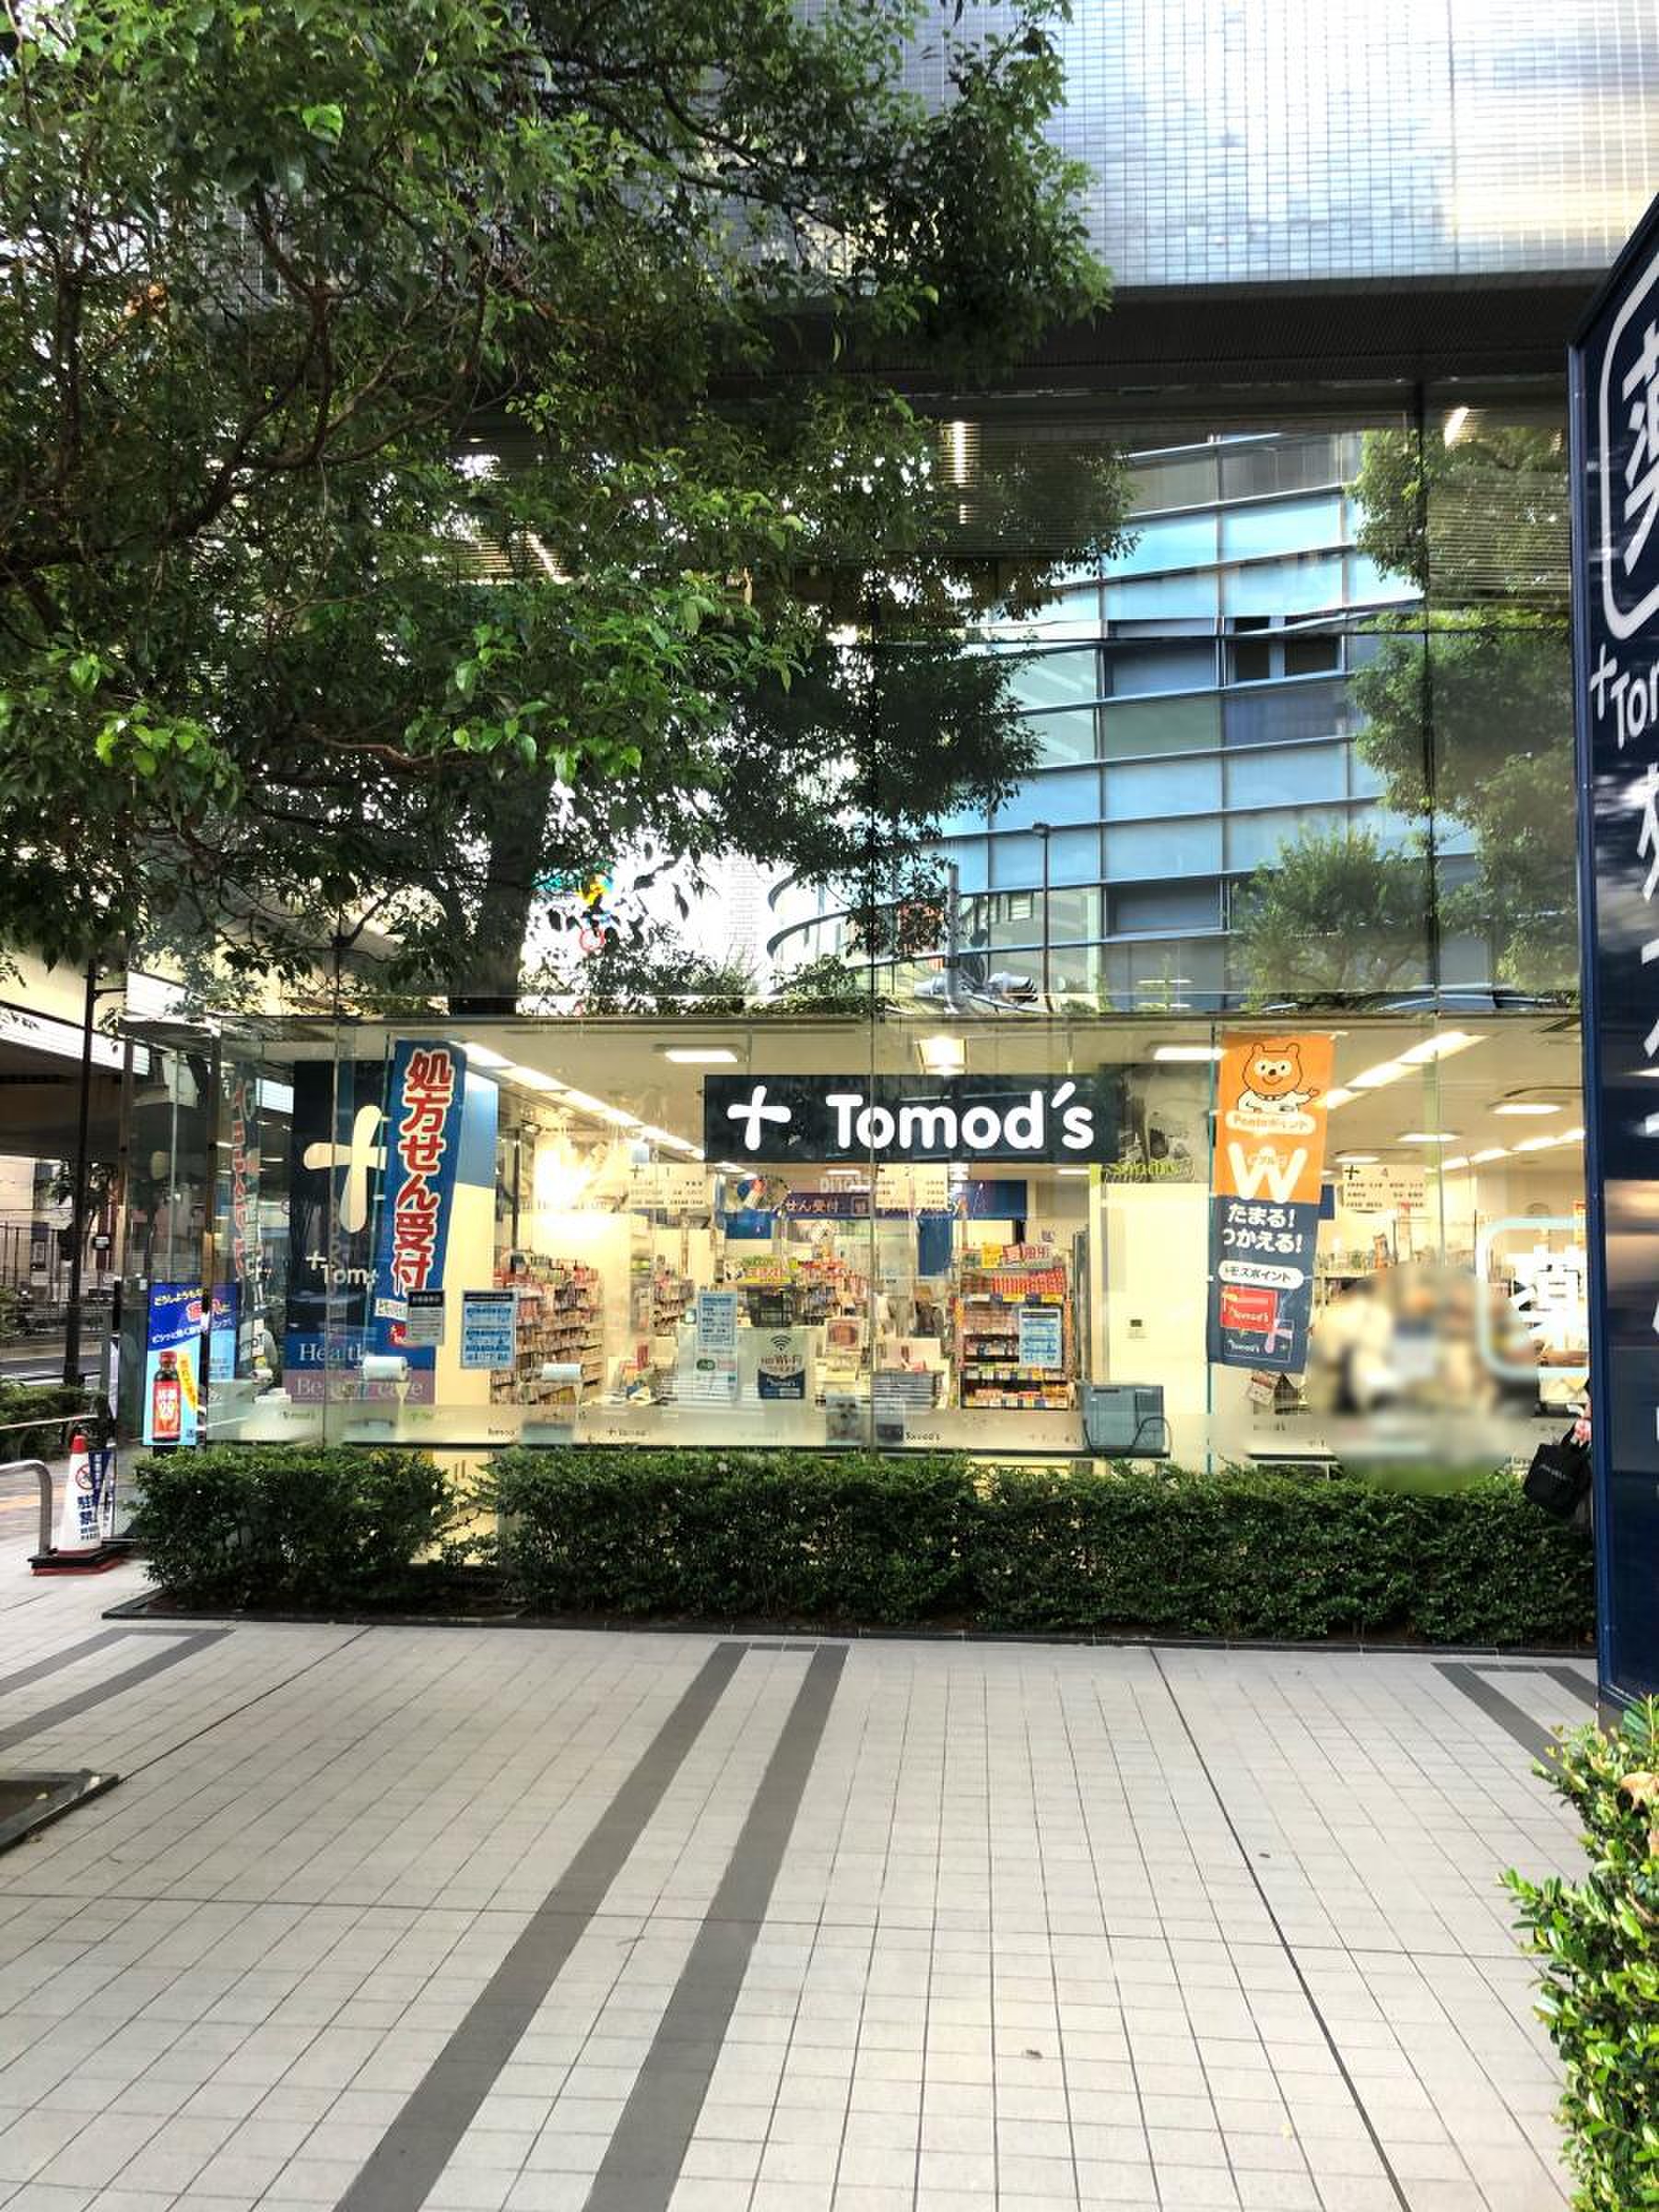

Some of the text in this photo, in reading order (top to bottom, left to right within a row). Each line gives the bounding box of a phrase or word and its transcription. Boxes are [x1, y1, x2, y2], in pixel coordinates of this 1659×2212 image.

[826, 1081, 1095, 1149] Tomod's
[391, 1048, 454, 1296] 処方せん受付
[1228, 1142, 1308, 1203] W
[1228, 1204, 1296, 1228] たまる!
[1224, 1229, 1302, 1253] つかえる!
[321, 1264, 378, 1286] Tom
